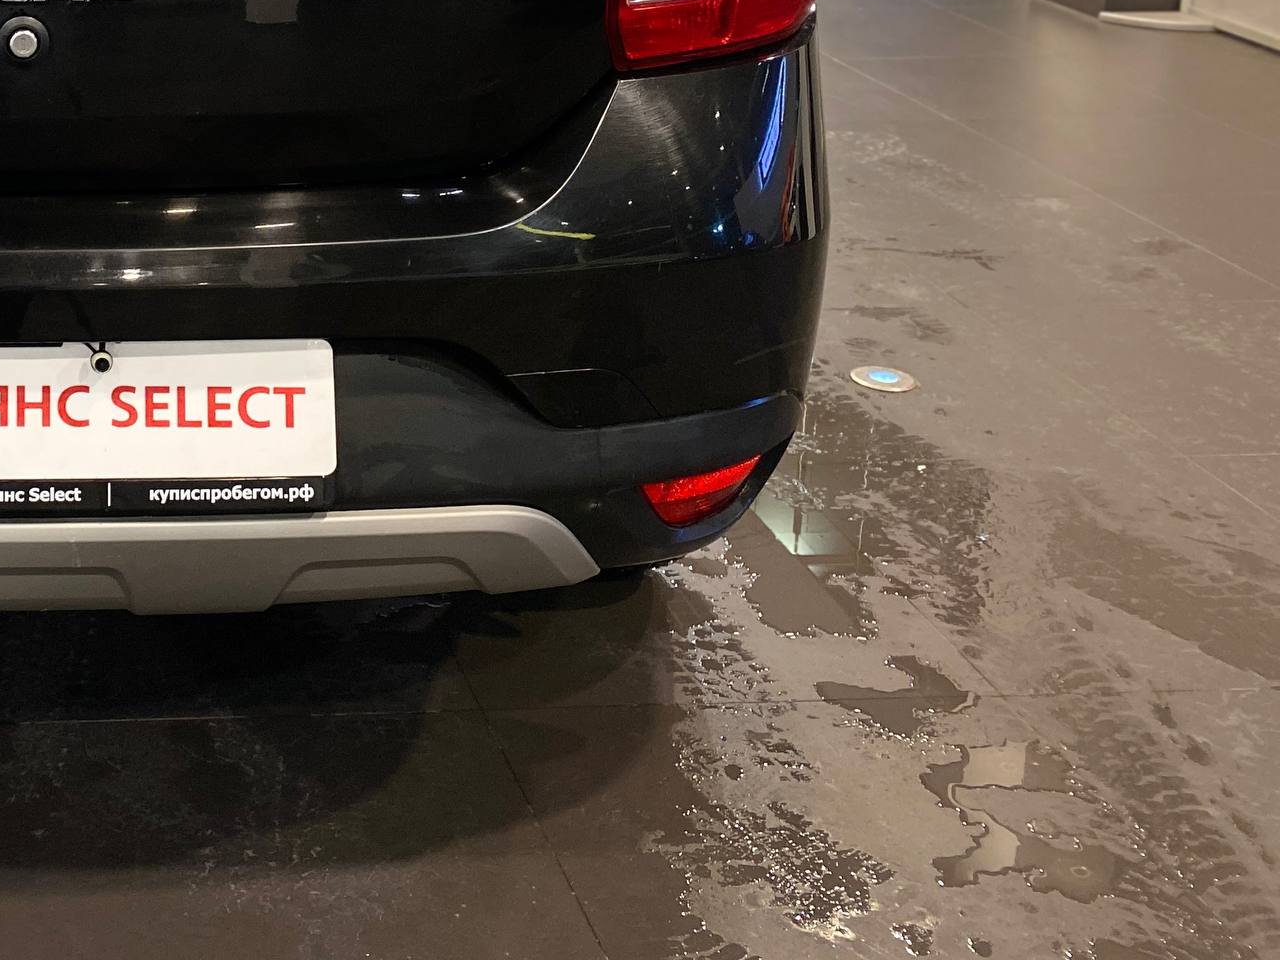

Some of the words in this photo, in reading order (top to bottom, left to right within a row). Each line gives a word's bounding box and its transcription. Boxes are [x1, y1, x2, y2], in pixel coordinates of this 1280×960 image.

[111, 385, 306, 429] SELECT
[28, 487, 82, 502] Select
[149, 485, 314, 503] куписпробегом.рф
